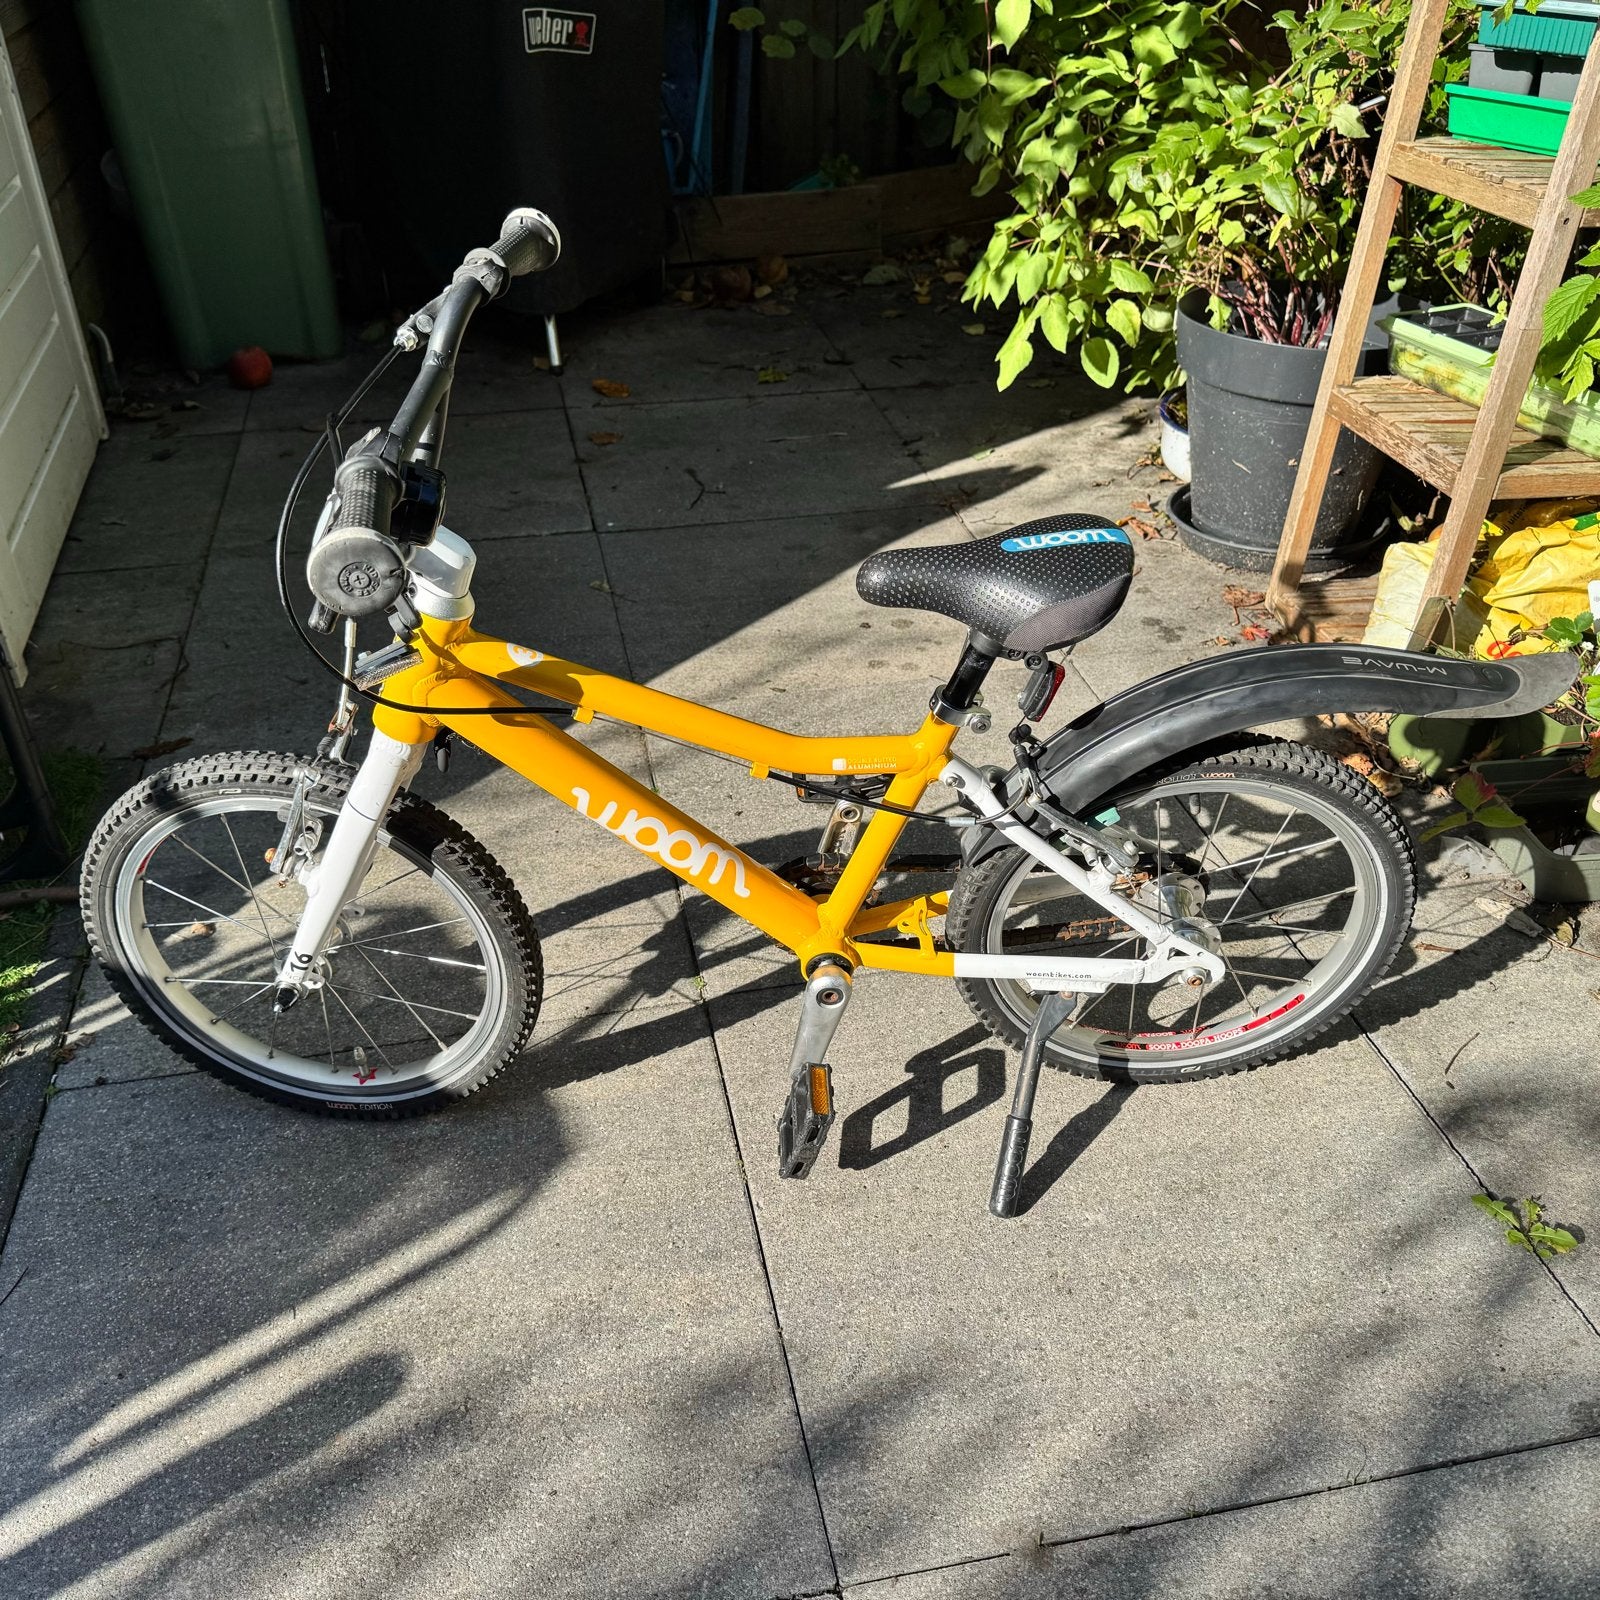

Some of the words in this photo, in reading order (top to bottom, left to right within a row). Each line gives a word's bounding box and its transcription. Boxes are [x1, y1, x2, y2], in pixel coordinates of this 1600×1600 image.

[528, 10, 573, 45] weber
[1012, 529, 1117, 548] woom
[1341, 656, 1448, 676] M-WAVE
[571, 787, 751, 898] woom
[290, 951, 313, 972] 16
[360, 1103, 393, 1111] EDITION
